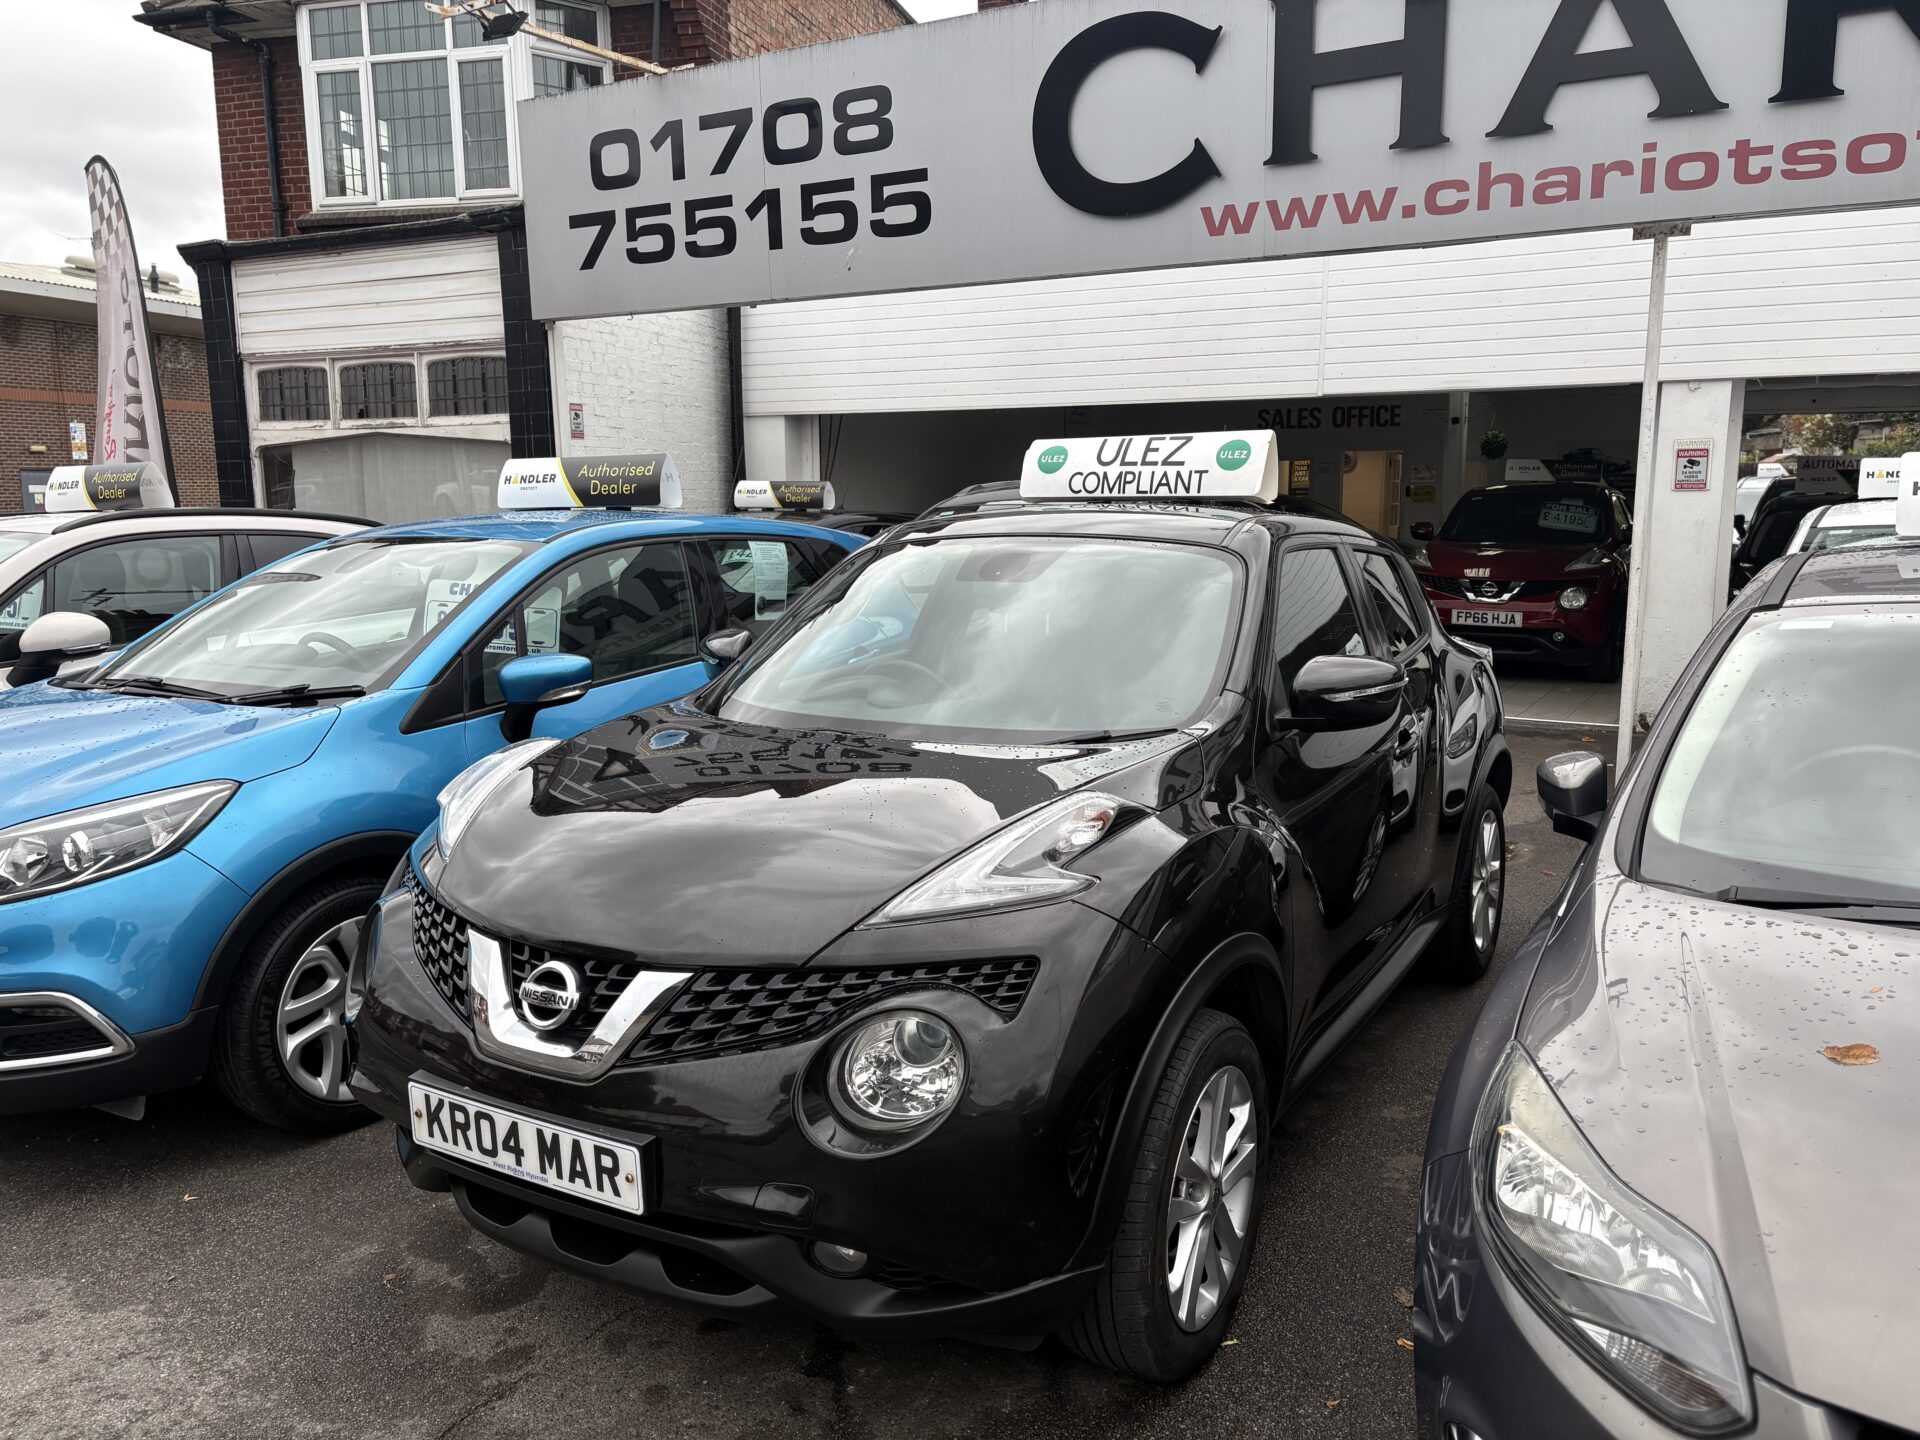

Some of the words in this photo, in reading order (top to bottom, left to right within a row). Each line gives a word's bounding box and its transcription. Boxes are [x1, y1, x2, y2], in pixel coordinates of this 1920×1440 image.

[589, 84, 894, 192] 01708
[1201, 131, 1920, 237] www.chariotso
[568, 167, 932, 271] 755155
[1256, 407, 1322, 430] SALES
[1331, 404, 1402, 429] OFFICE
[1041, 454, 1065, 464] ULEZ
[1096, 435, 1194, 467] ULEZ
[1220, 449, 1248, 460] ULEZ
[91, 468, 140, 484] Authorised
[578, 461, 655, 478] Authorised
[49, 480, 80, 491] HANDLER
[504, 473, 556, 485] HANDLER
[1067, 469, 1209, 496] COMPLIANT
[98, 485, 127, 499] Dealer
[590, 480, 637, 495] Dealer
[779, 485, 822, 494] Authorised
[785, 493, 812, 502] Dealer
[1456, 611, 1489, 624] FP66
[1491, 613, 1516, 625] HJA
[521, 986, 568, 1007] NISSAN
[423, 1093, 526, 1168] KR04
[535, 1127, 622, 1199] MAR
